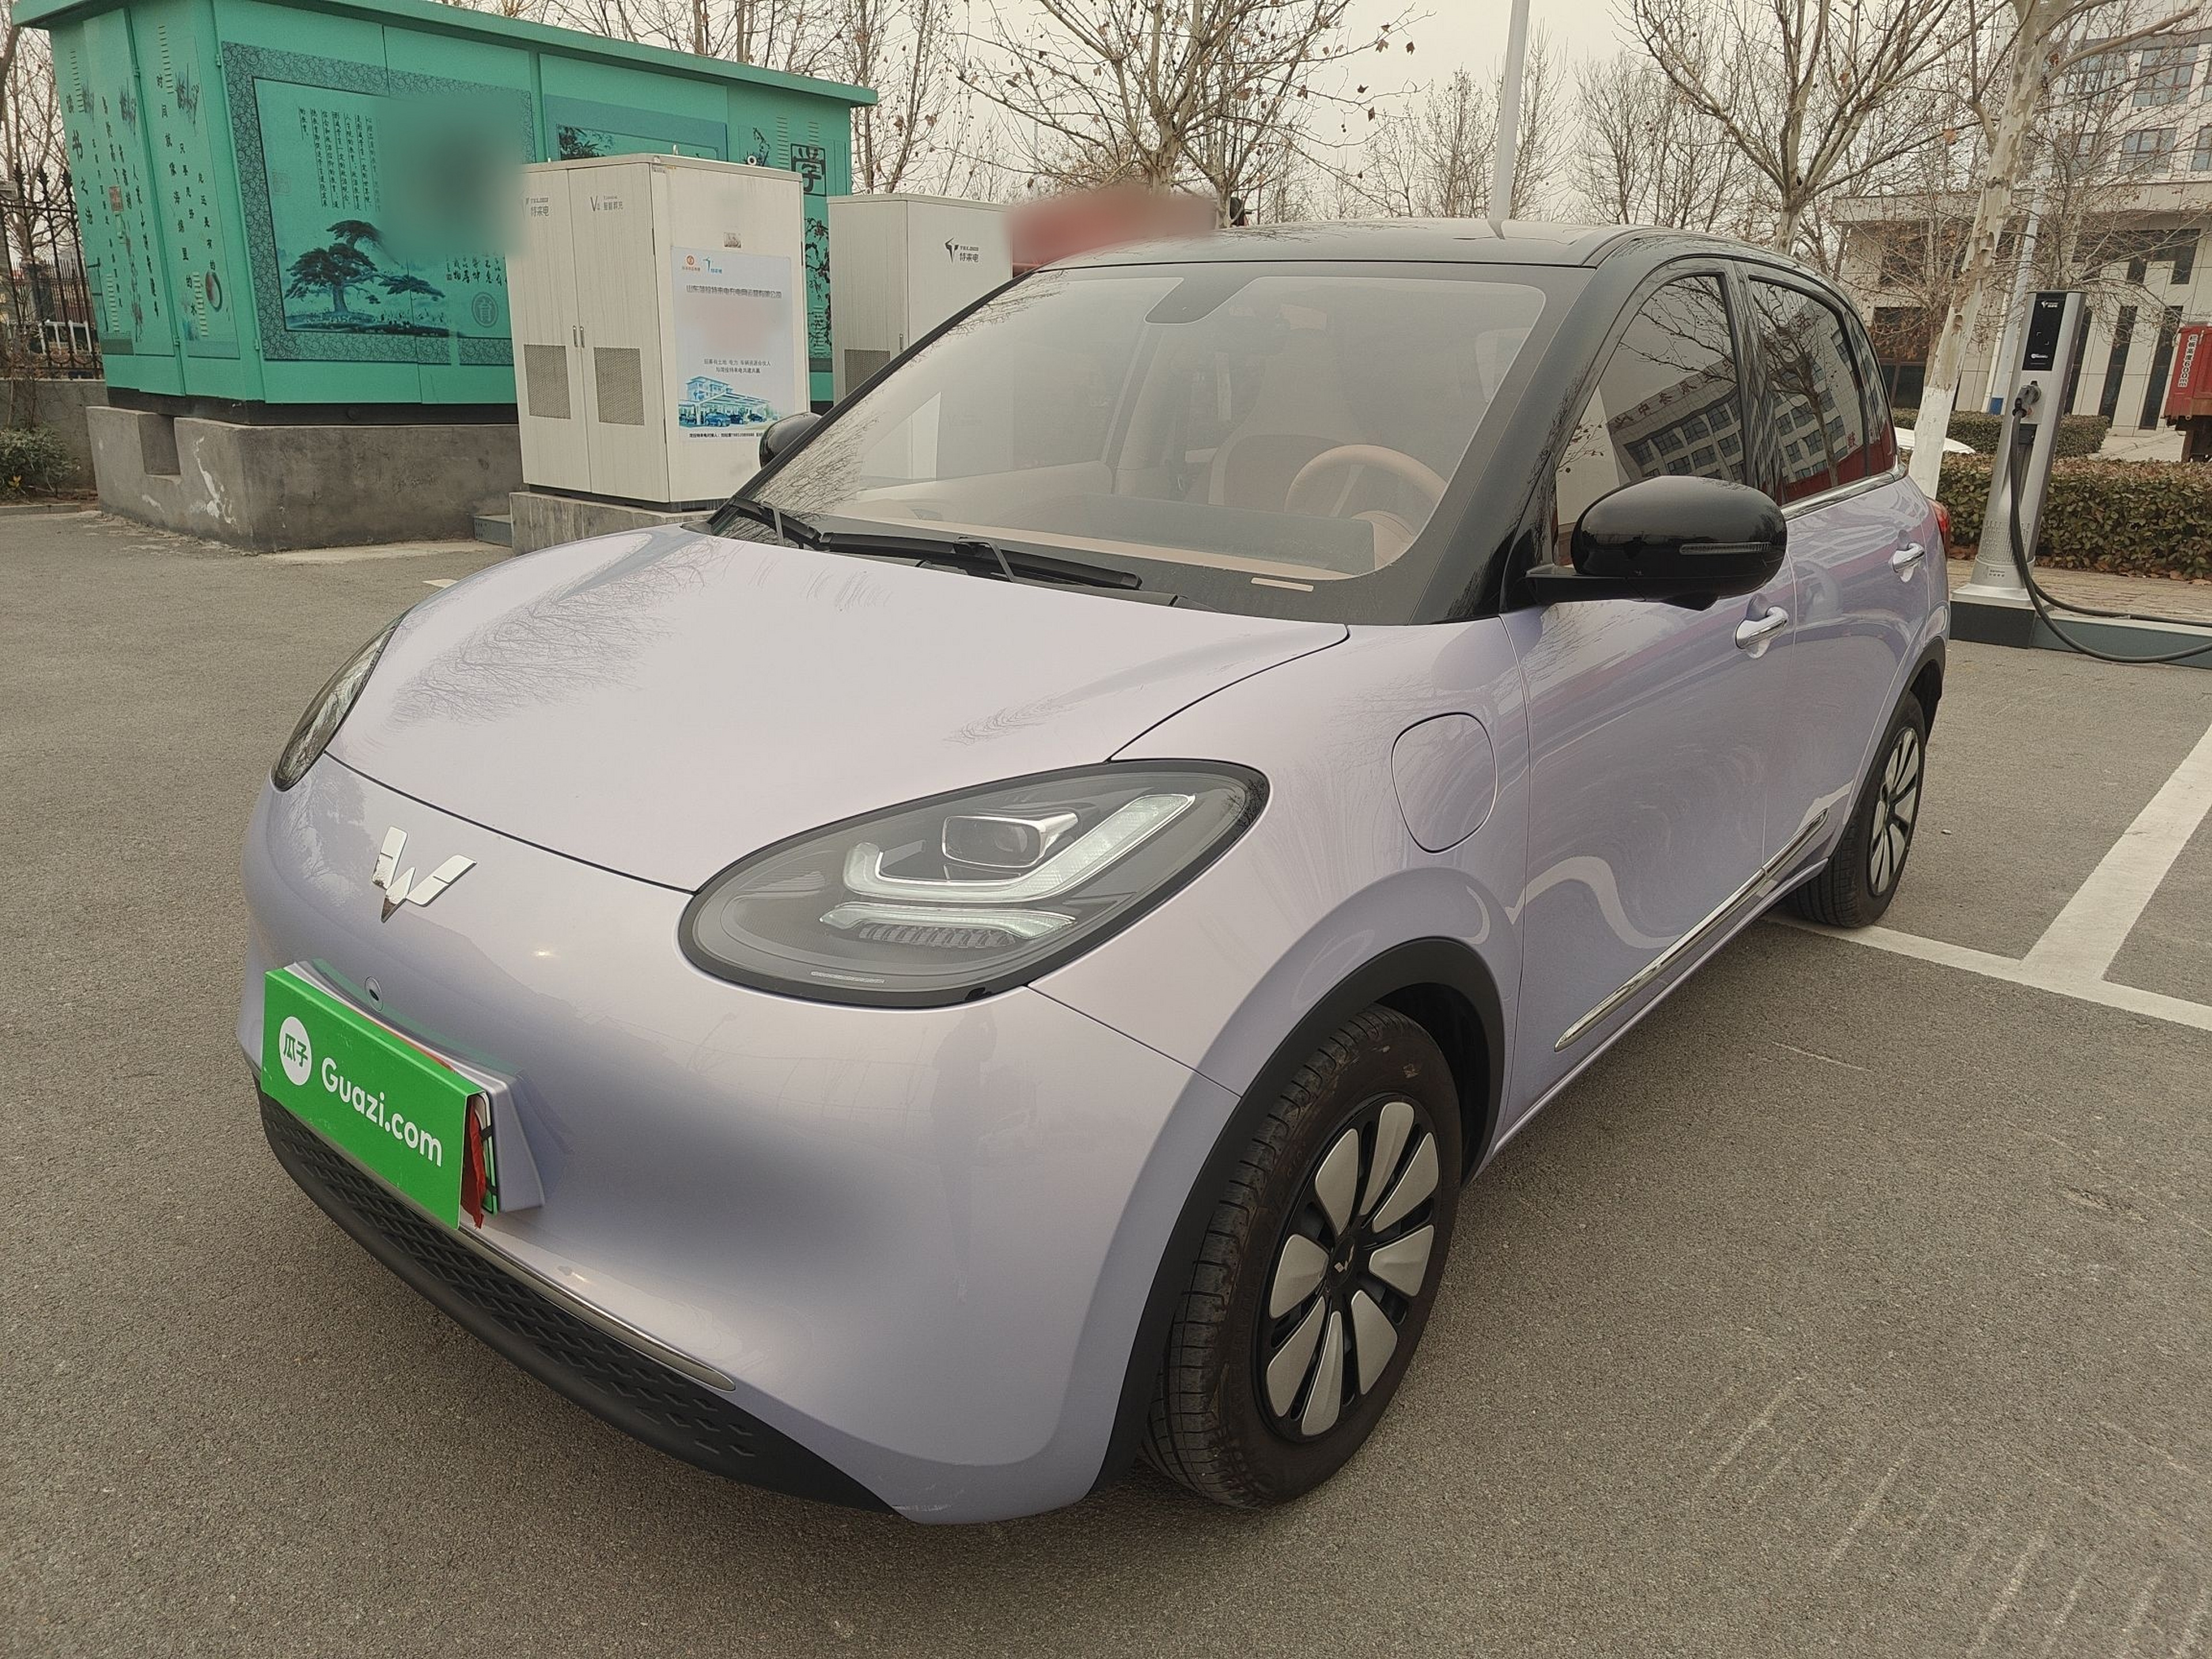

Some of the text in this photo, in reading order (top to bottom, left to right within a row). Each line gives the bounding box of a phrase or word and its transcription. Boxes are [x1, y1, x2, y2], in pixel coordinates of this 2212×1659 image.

[791, 147, 825, 192] 学
[959, 252, 979, 263] 特来电
[284, 1033, 308, 1067] 瓜子
[322, 1058, 442, 1167] Guazi.com
